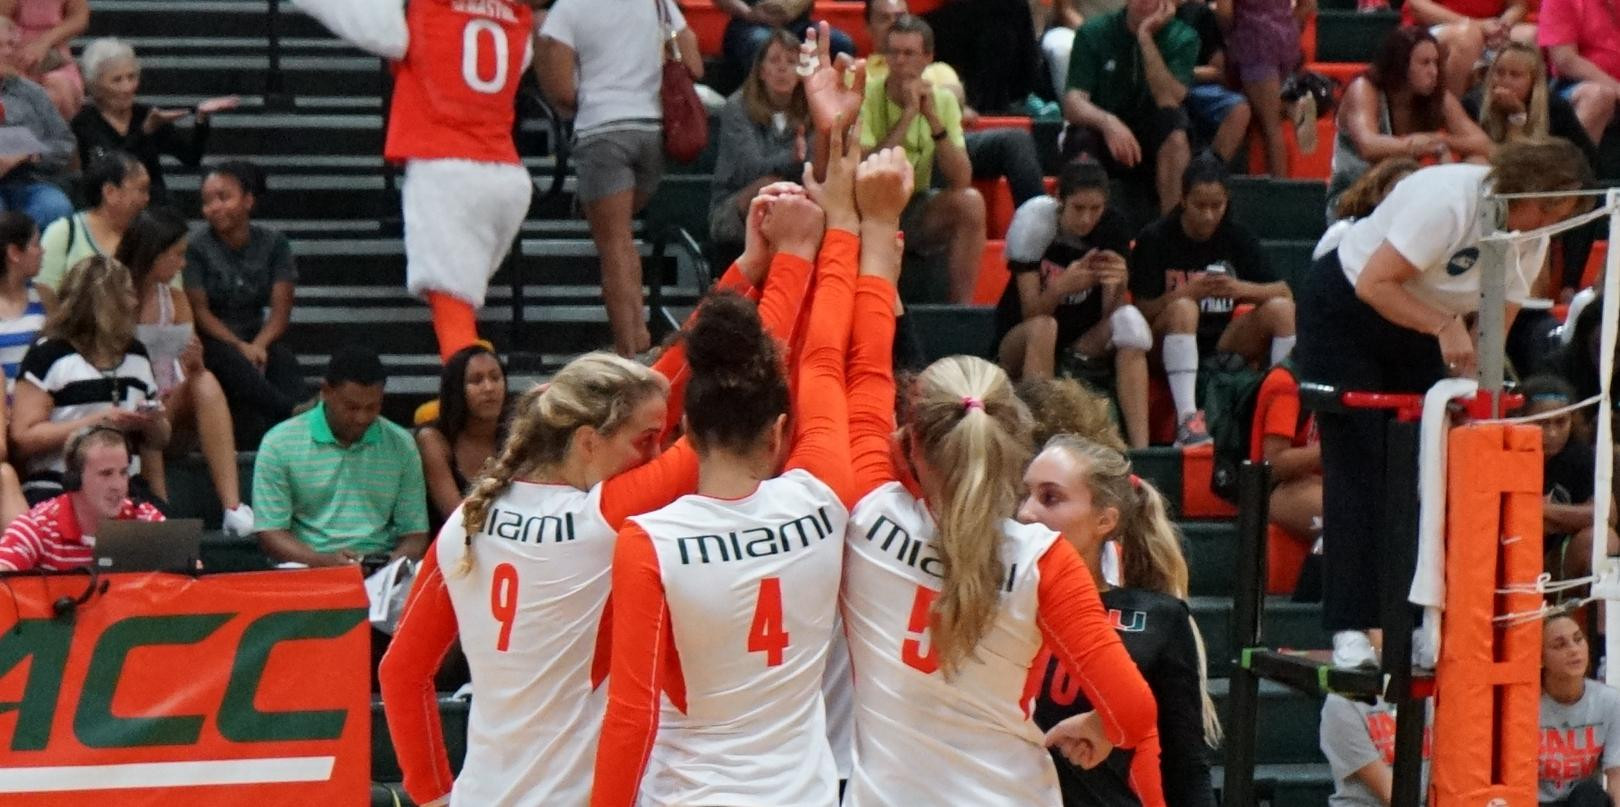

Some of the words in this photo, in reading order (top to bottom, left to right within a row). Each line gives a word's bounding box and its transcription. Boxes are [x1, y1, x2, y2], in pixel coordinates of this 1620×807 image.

[464, 18, 508, 93] 0
[480, 509, 574, 543] iami
[491, 563, 518, 651] 9
[747, 577, 788, 667] 4
[902, 585, 944, 674] 5
[1108, 609, 1146, 631] U
[0, 608, 369, 750] ACC
